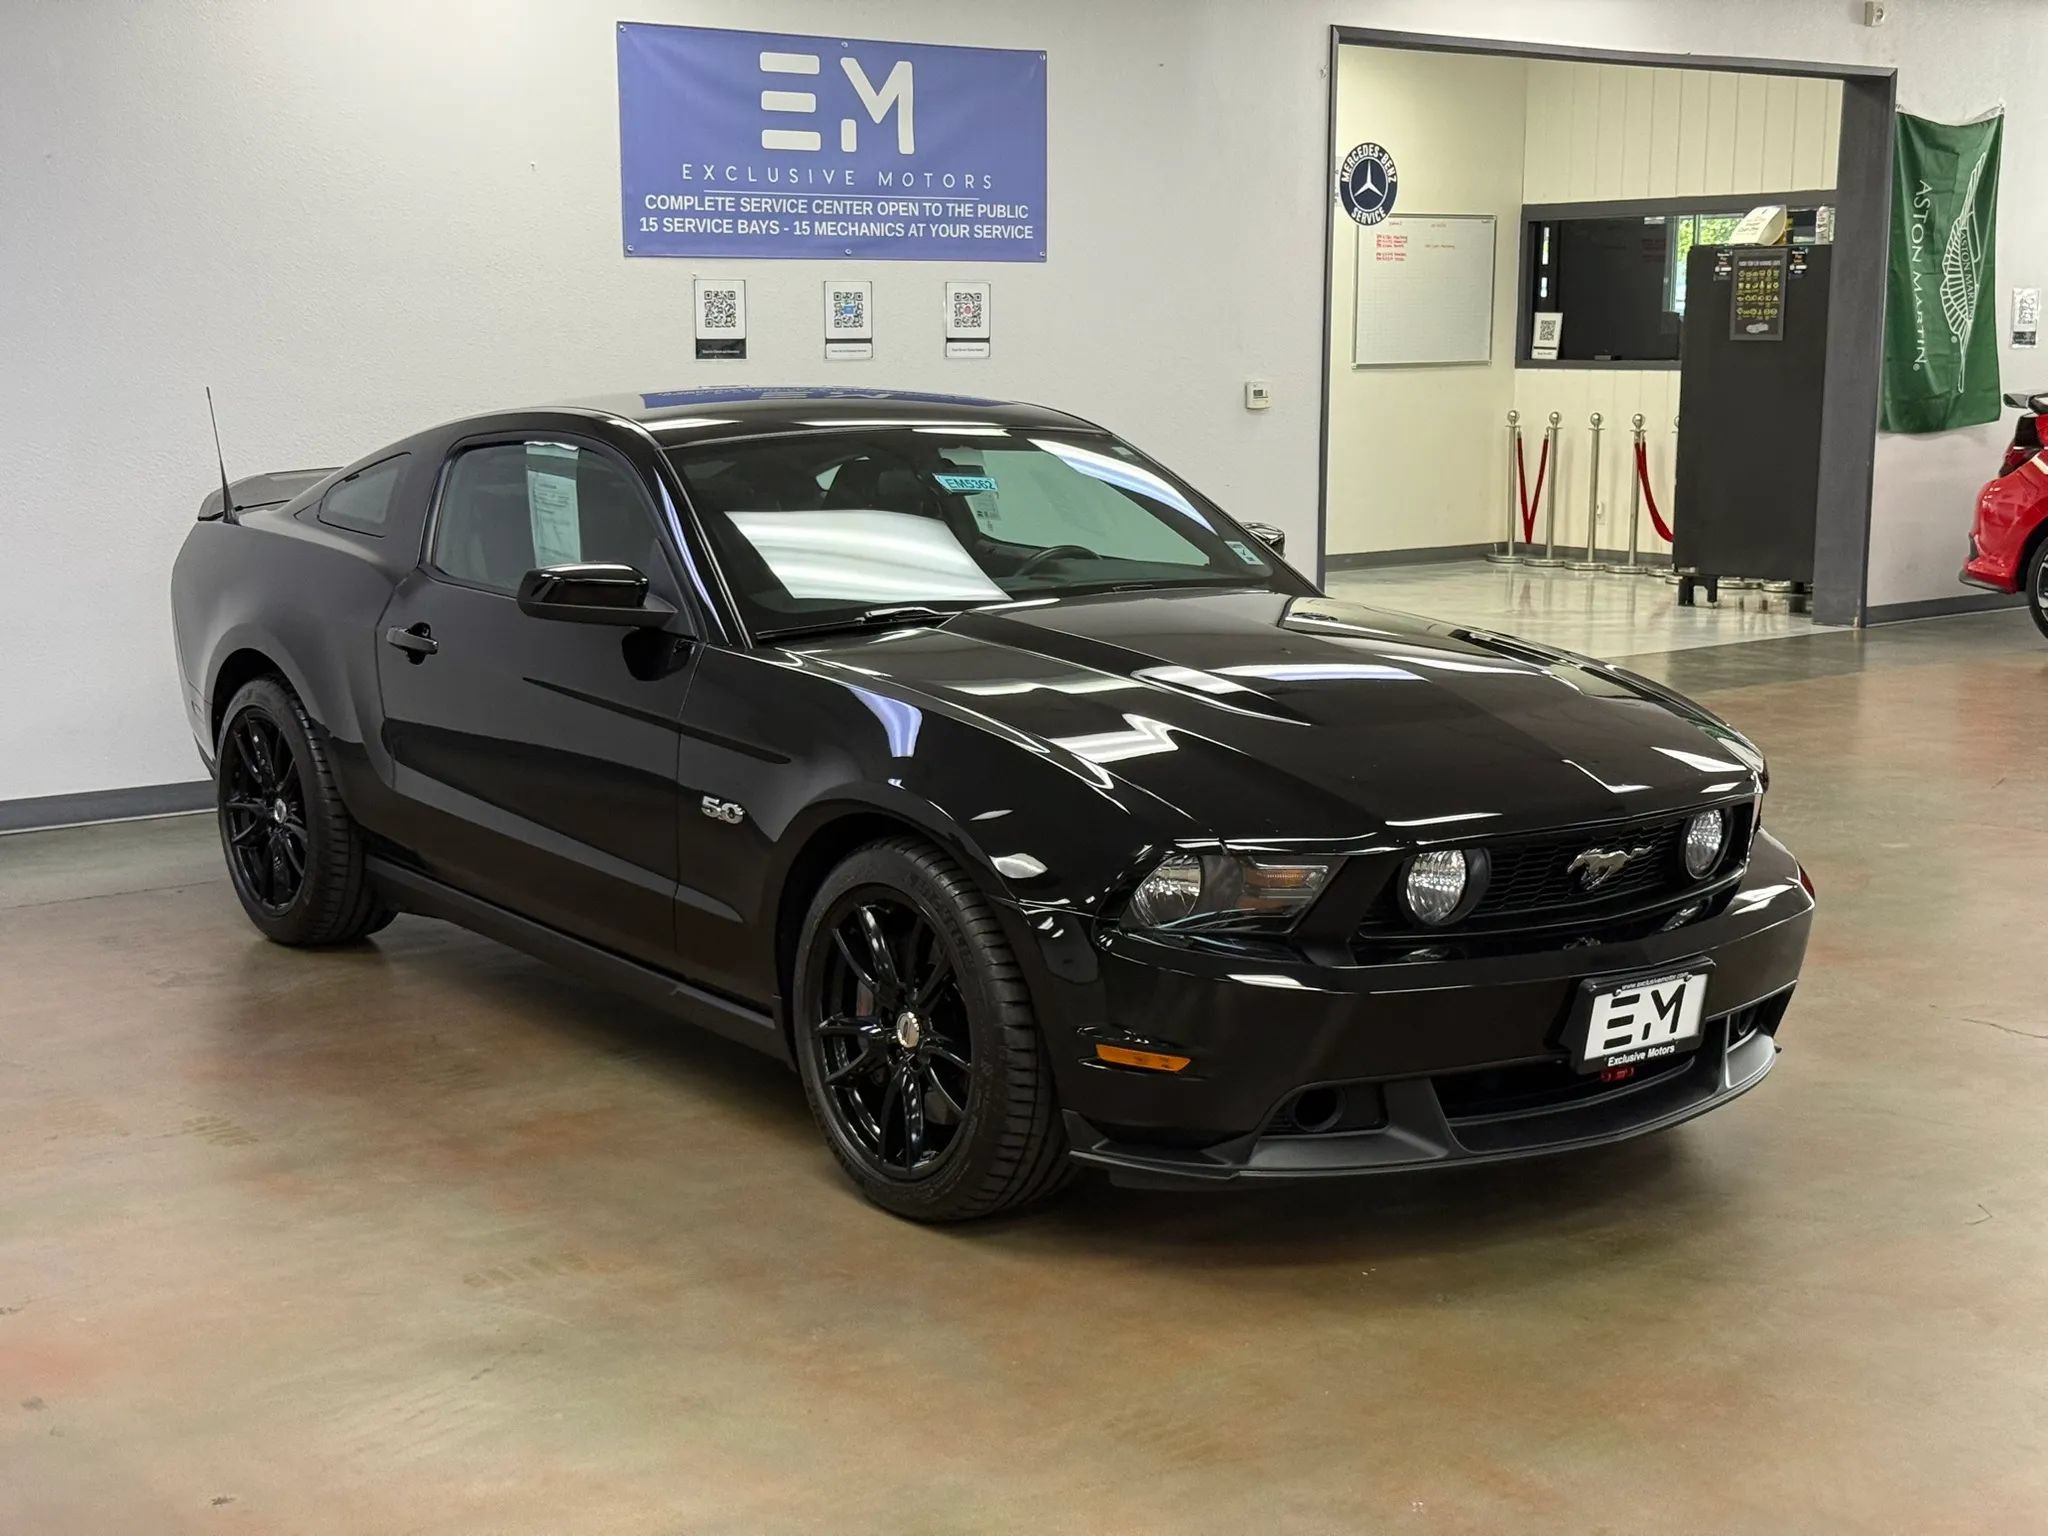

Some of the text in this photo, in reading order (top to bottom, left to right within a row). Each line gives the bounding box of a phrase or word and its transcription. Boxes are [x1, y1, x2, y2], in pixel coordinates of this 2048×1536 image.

[760, 52, 915, 154] EM
[682, 163, 992, 190] EXCLUSIVE MOTORS
[645, 194, 1029, 219] COMPLETE SERVICE CENTER OPEN TO THE PUBLIC
[1351, 207, 1387, 225] SERVICE
[639, 217, 658, 232] 15
[662, 217, 733, 234] SERVICE
[737, 219, 780, 235] BAYS
[793, 220, 811, 236] 15
[814, 221, 905, 238] MECHANICS
[908, 223, 927, 237] AT
[929, 223, 970, 239] YOUR
[973, 224, 1034, 240] SERVICE
[1960, 231, 1971, 271] ASTON
[1911, 179, 1933, 364] ASTON MARTIN
[944, 478, 996, 490] EM5362
[1602, 983, 1687, 1049] EM
[1607, 1044, 1675, 1067] Exclusive Motors
